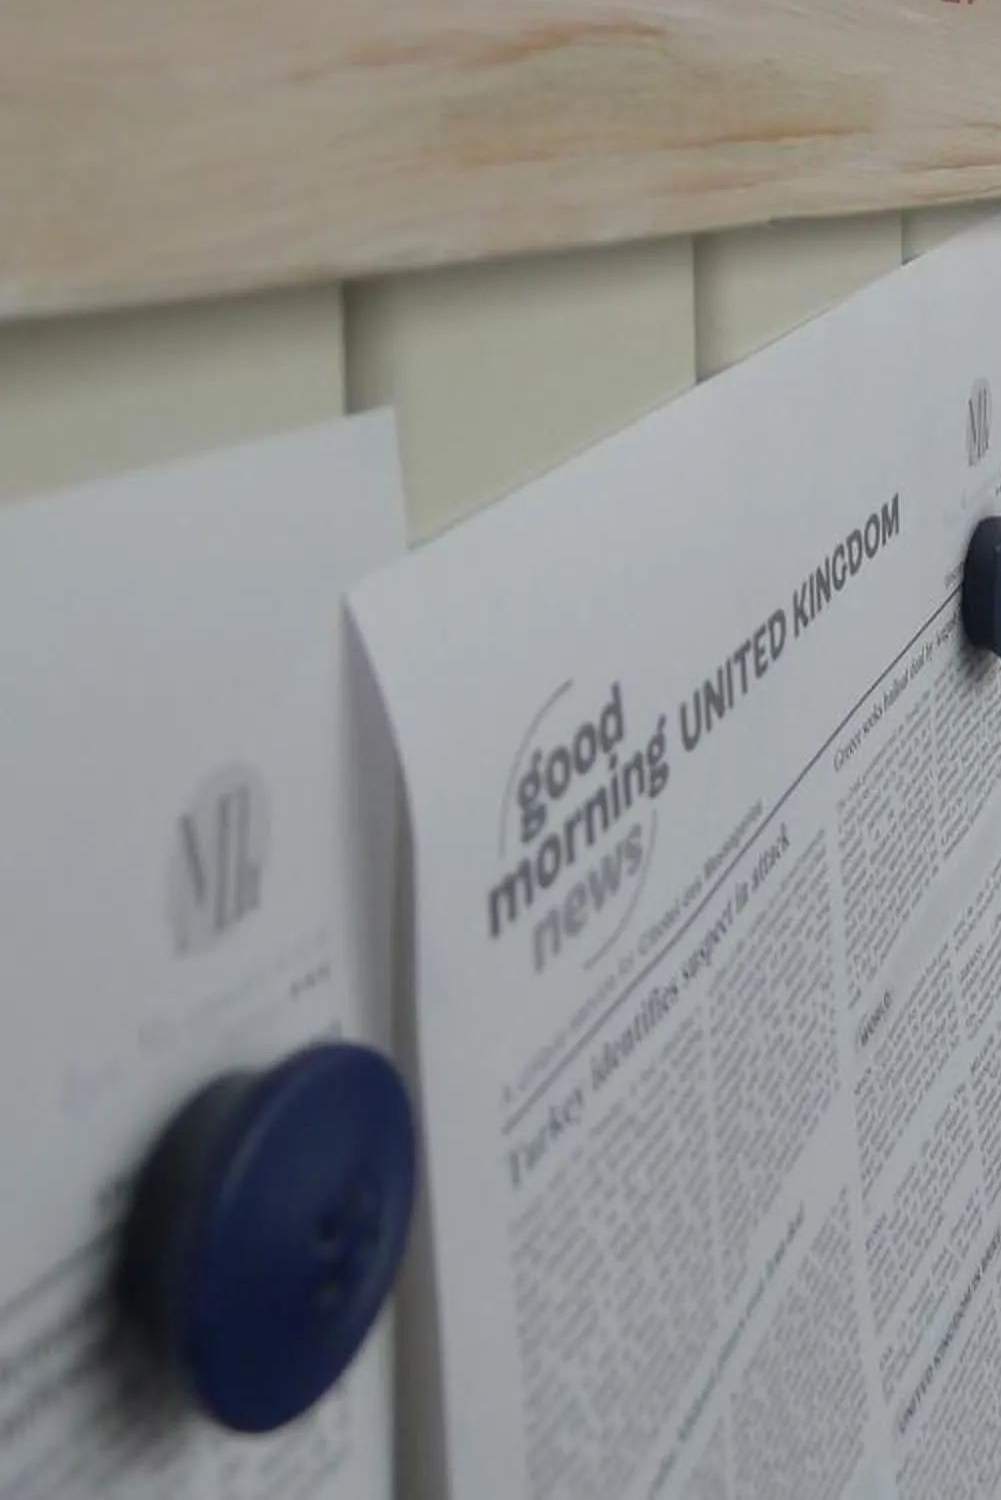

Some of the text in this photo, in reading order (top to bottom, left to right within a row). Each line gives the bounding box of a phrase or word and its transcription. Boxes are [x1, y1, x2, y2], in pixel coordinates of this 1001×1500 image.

[487, 713, 671, 940] morning
[679, 607, 788, 753] UNITED
[792, 492, 901, 639] KINGDOM
[517, 680, 626, 845] good
[531, 822, 644, 976] news
